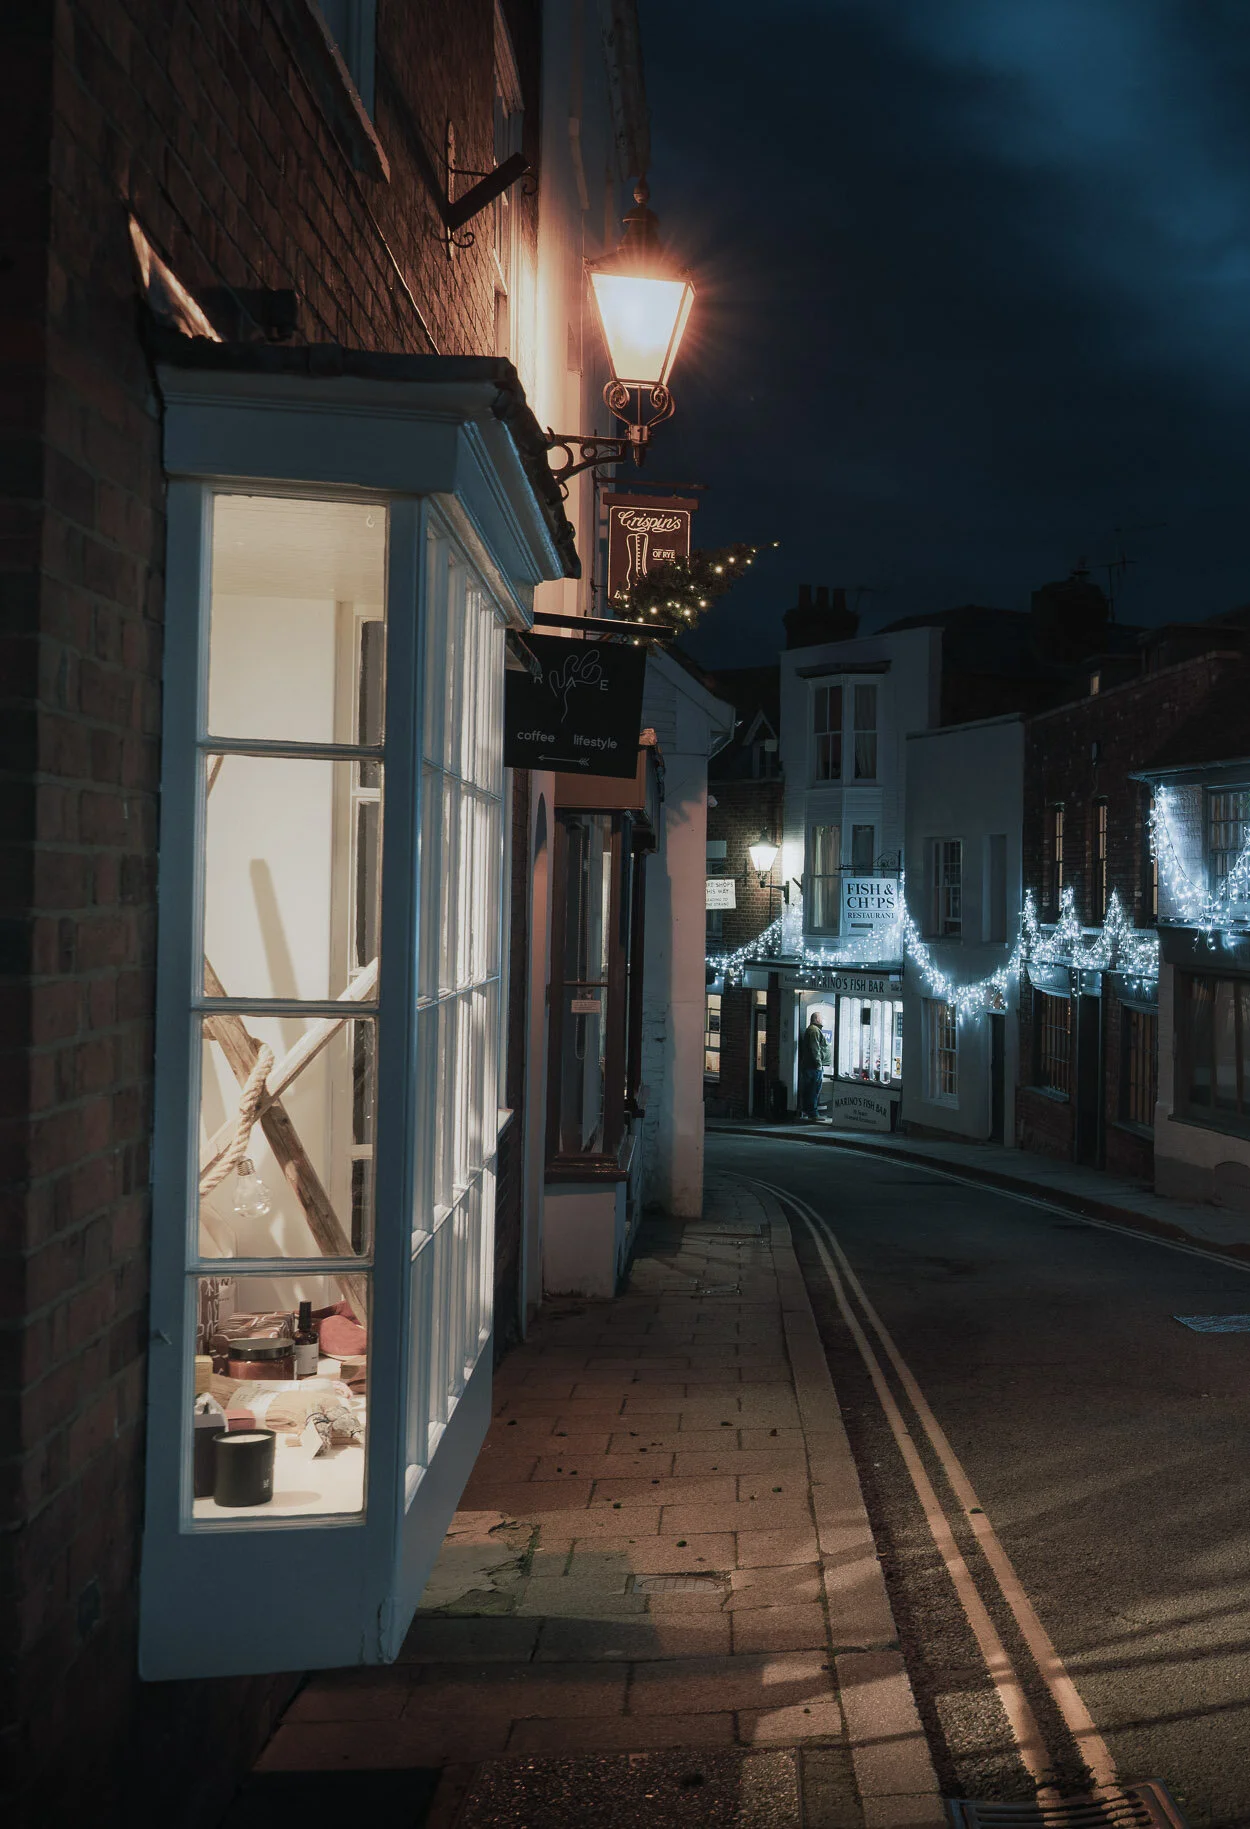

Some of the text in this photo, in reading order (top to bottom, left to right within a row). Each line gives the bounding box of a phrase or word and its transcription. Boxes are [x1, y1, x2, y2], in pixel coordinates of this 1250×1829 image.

[617, 510, 682, 533] Crispin's
[652, 550, 676, 559] OF RYE
[517, 730, 618, 750] coffee lifestyle
[846, 883, 894, 895] FISH &
[850, 978, 866, 992] FISH
[868, 979, 885, 993] BAR
[834, 1096, 862, 1108] MARINO'S
[863, 1098, 875, 1111] FISH
[876, 1103, 887, 1119] BAR
